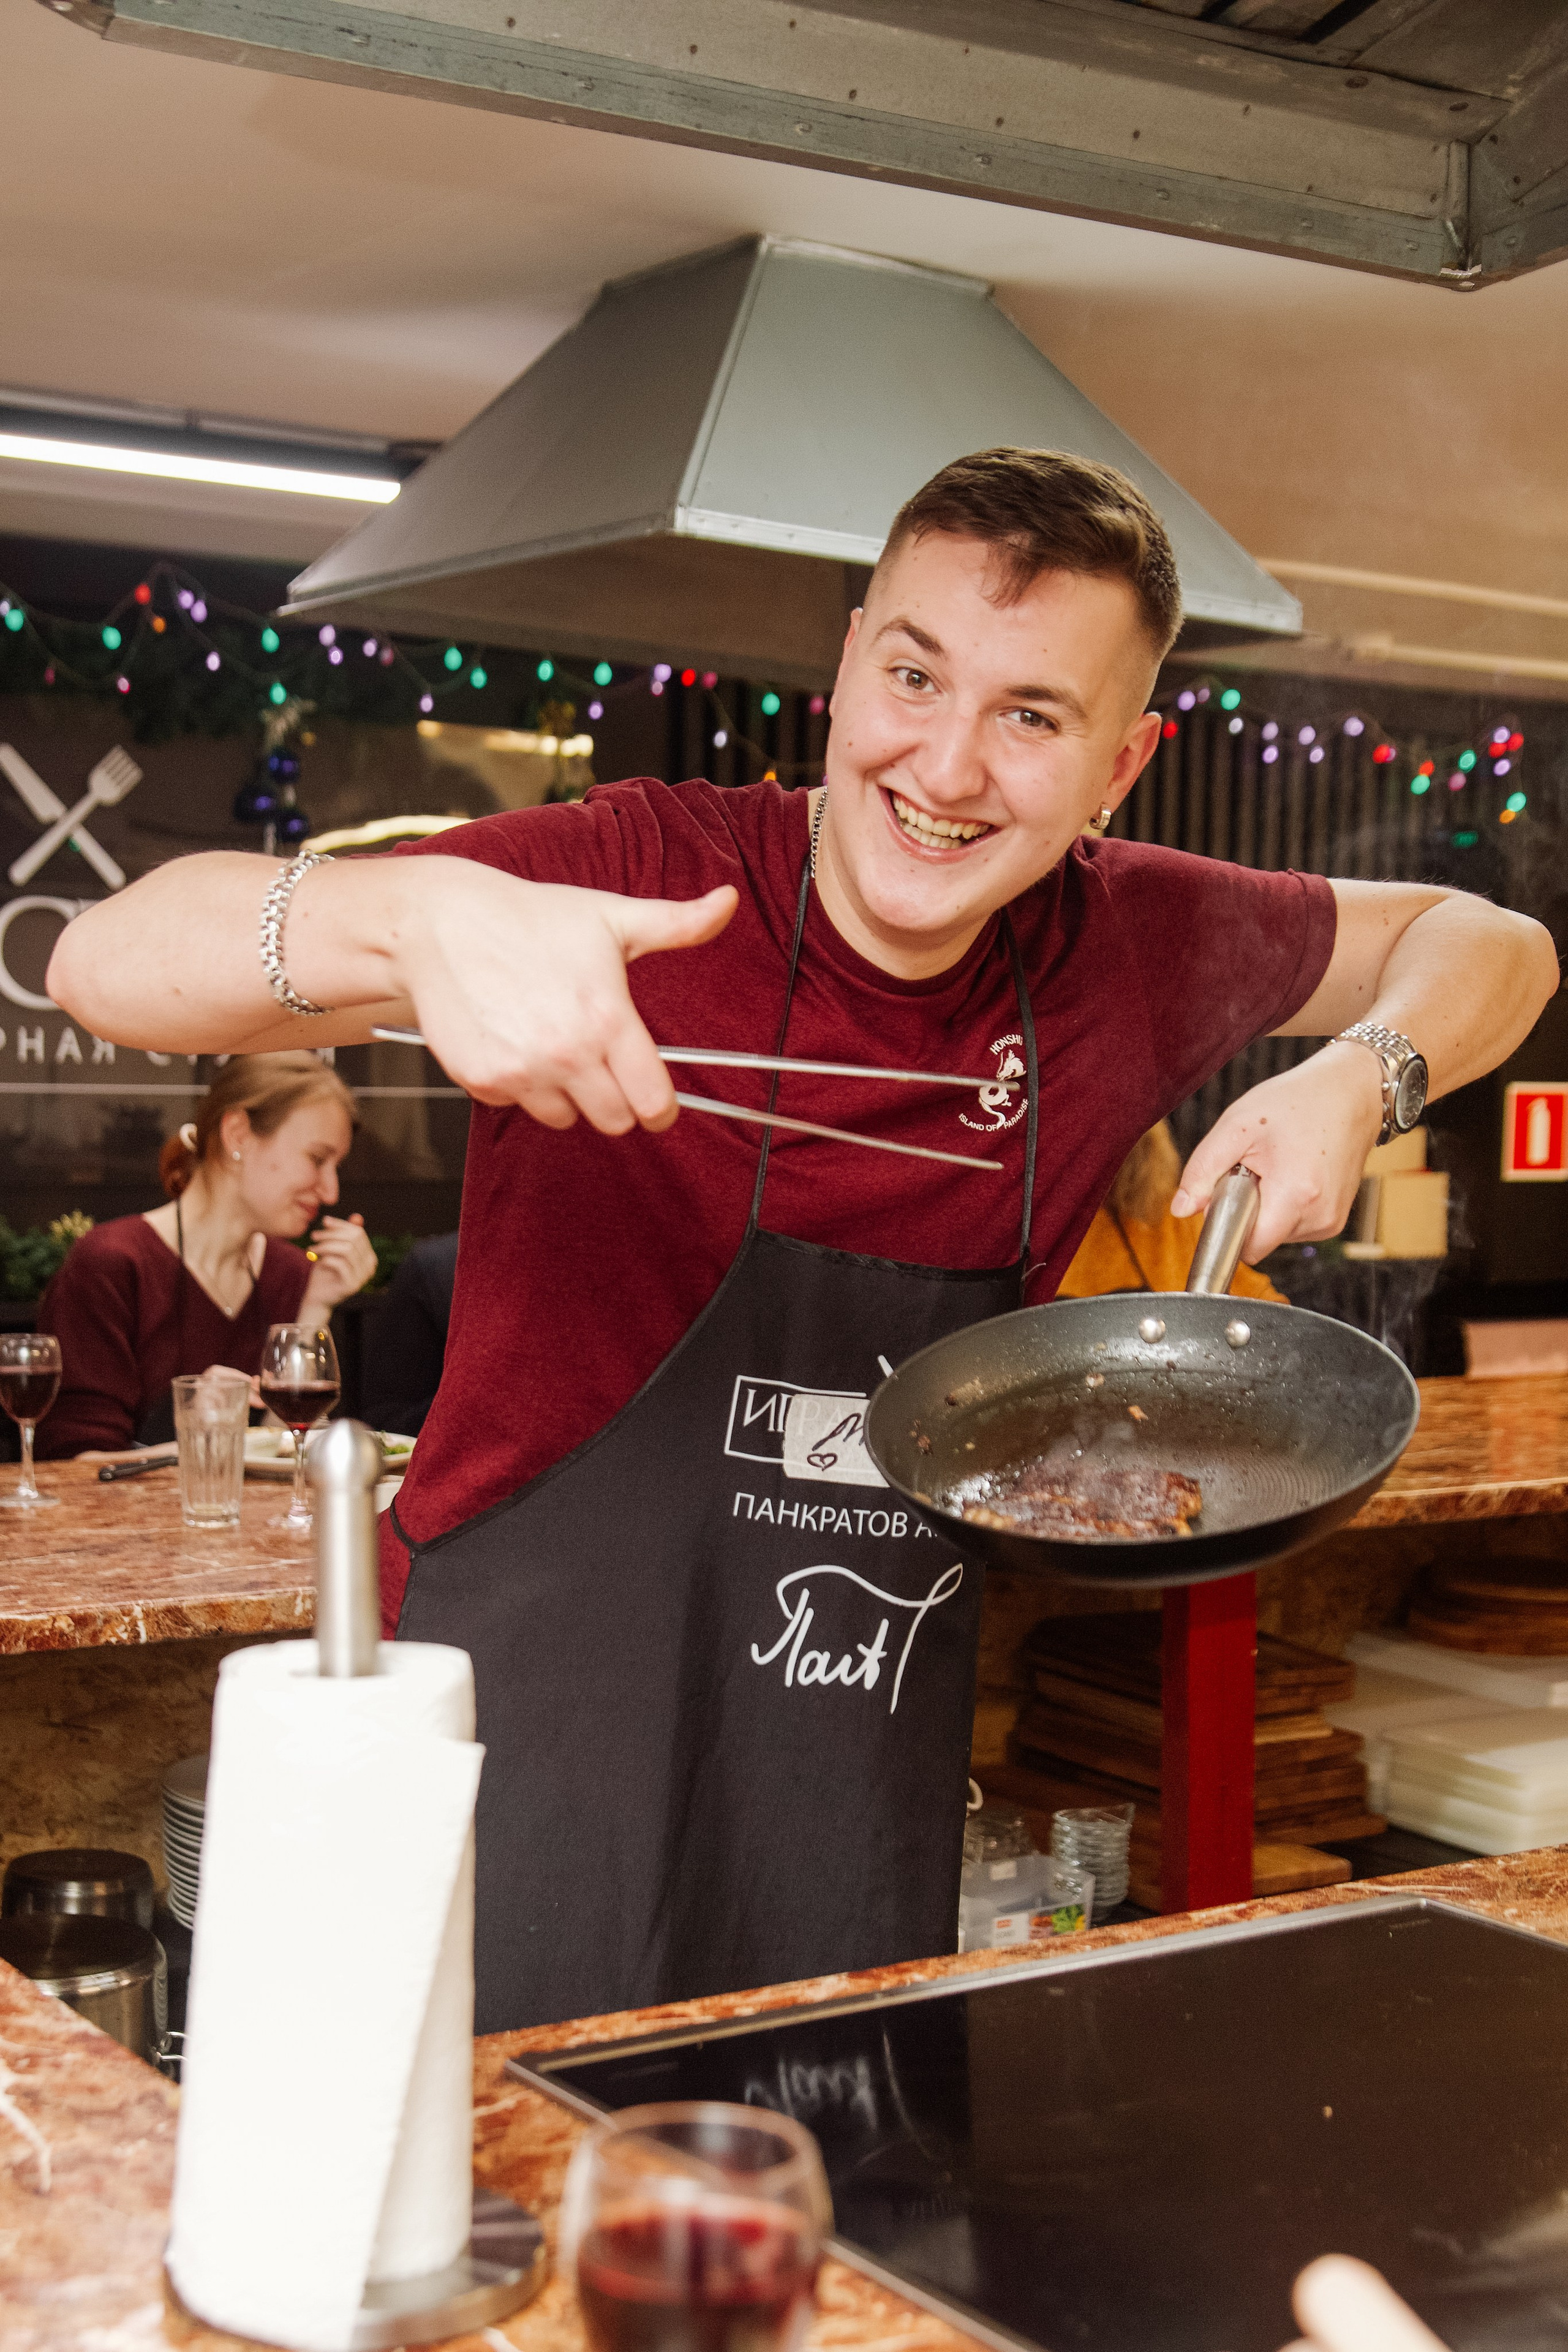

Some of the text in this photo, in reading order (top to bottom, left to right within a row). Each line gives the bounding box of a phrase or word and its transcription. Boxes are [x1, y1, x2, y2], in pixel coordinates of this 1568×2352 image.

[989, 1034, 1023, 1055] HONSHU
[959, 1114, 984, 1131] ISLAND
[1004, 1098, 1028, 1129] PARADISE
[733, 1491, 908, 1537] ПАНКРАТОВ
